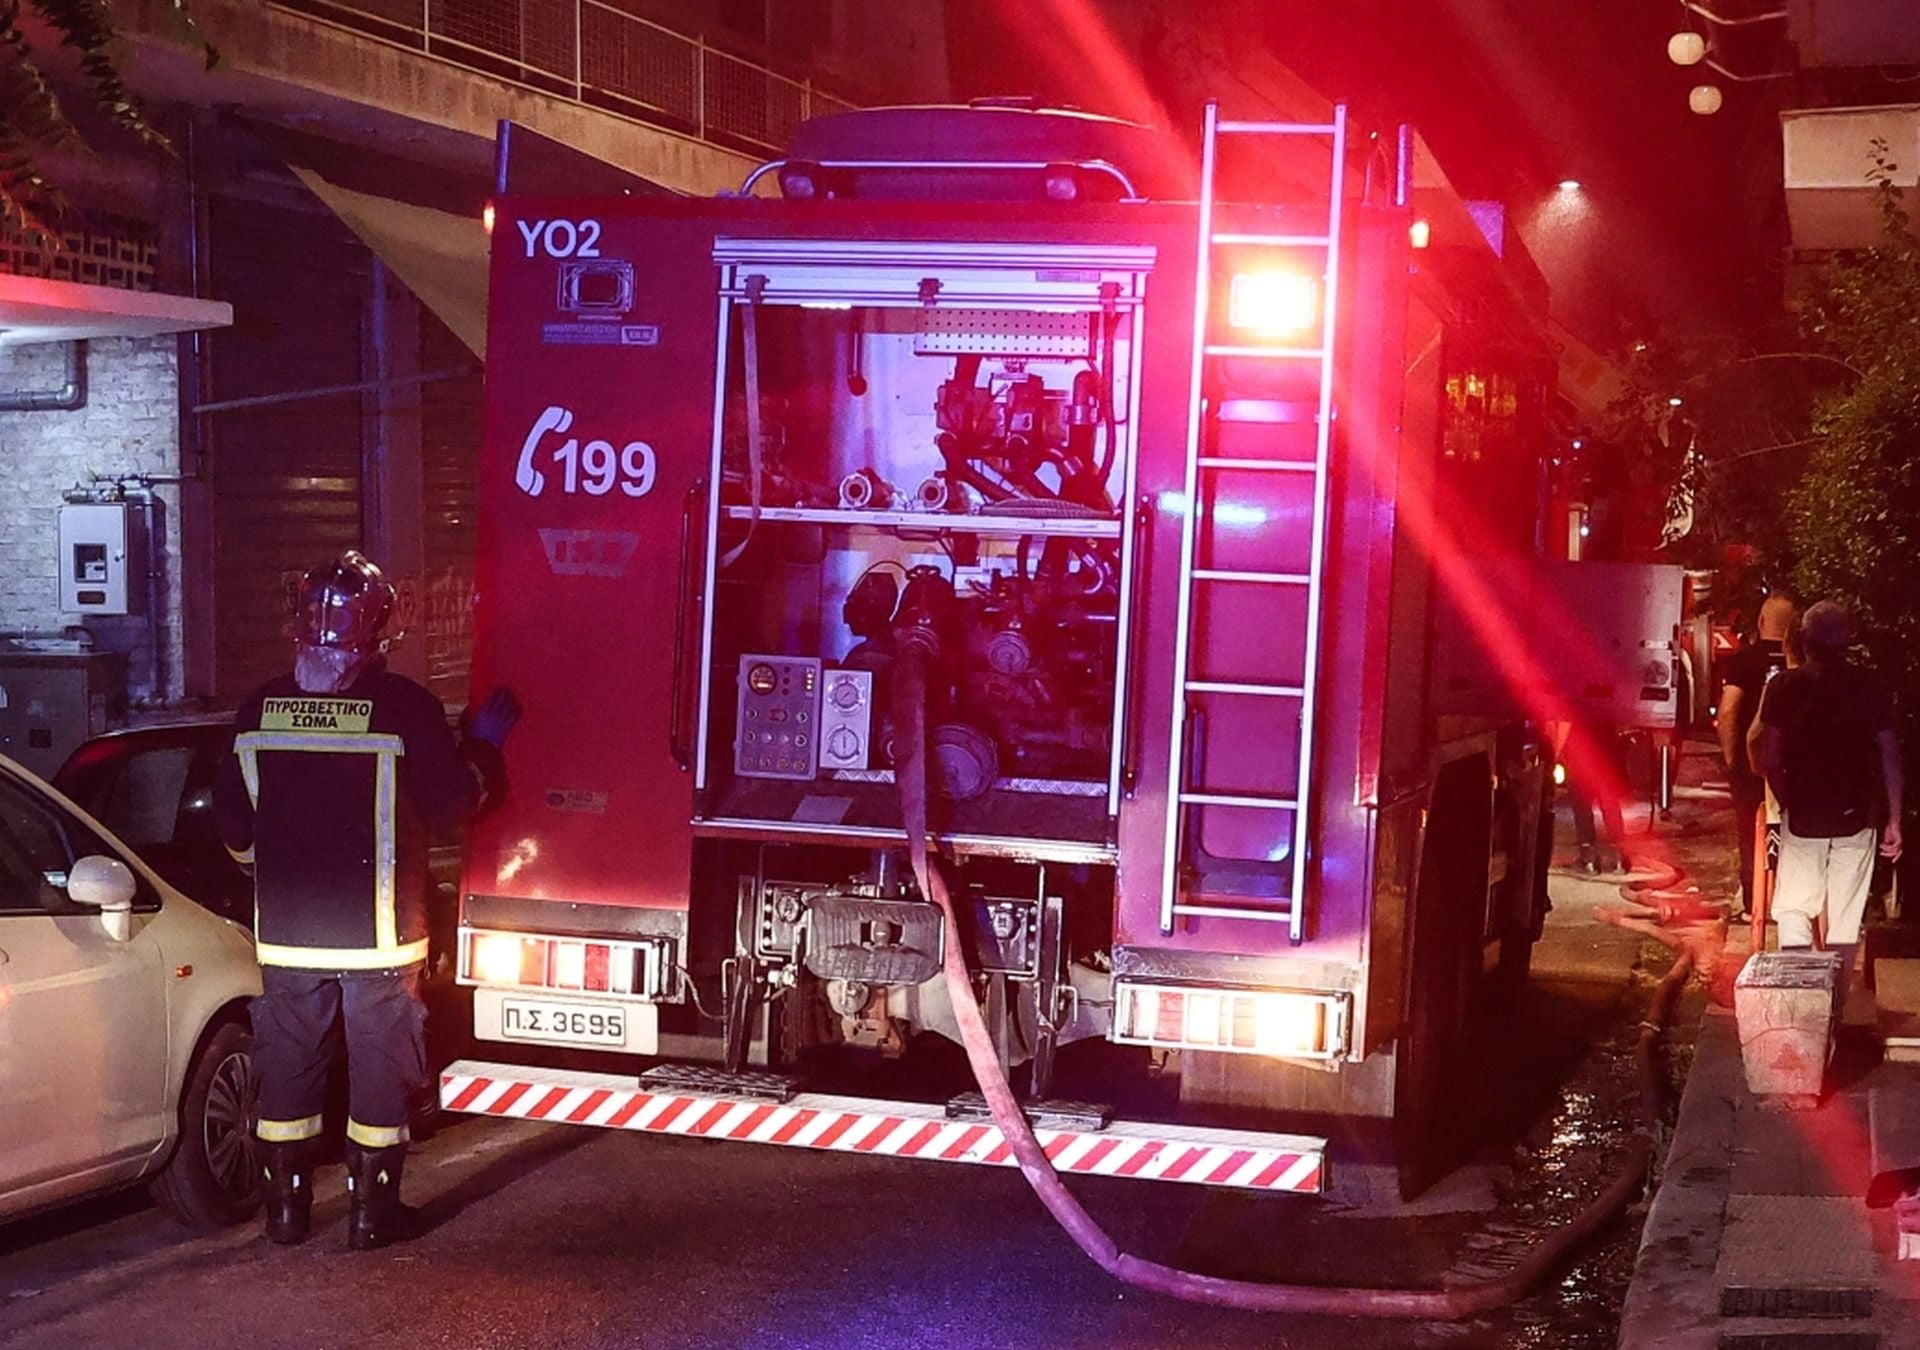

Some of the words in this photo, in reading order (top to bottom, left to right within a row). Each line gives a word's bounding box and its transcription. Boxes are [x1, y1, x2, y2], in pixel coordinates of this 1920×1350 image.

[553, 439, 656, 497] 199
[265, 700, 370, 716] ΠΥΡΟΣΒΕΣΤΙΚΟ
[291, 714, 338, 729] ΣΩΜΑ
